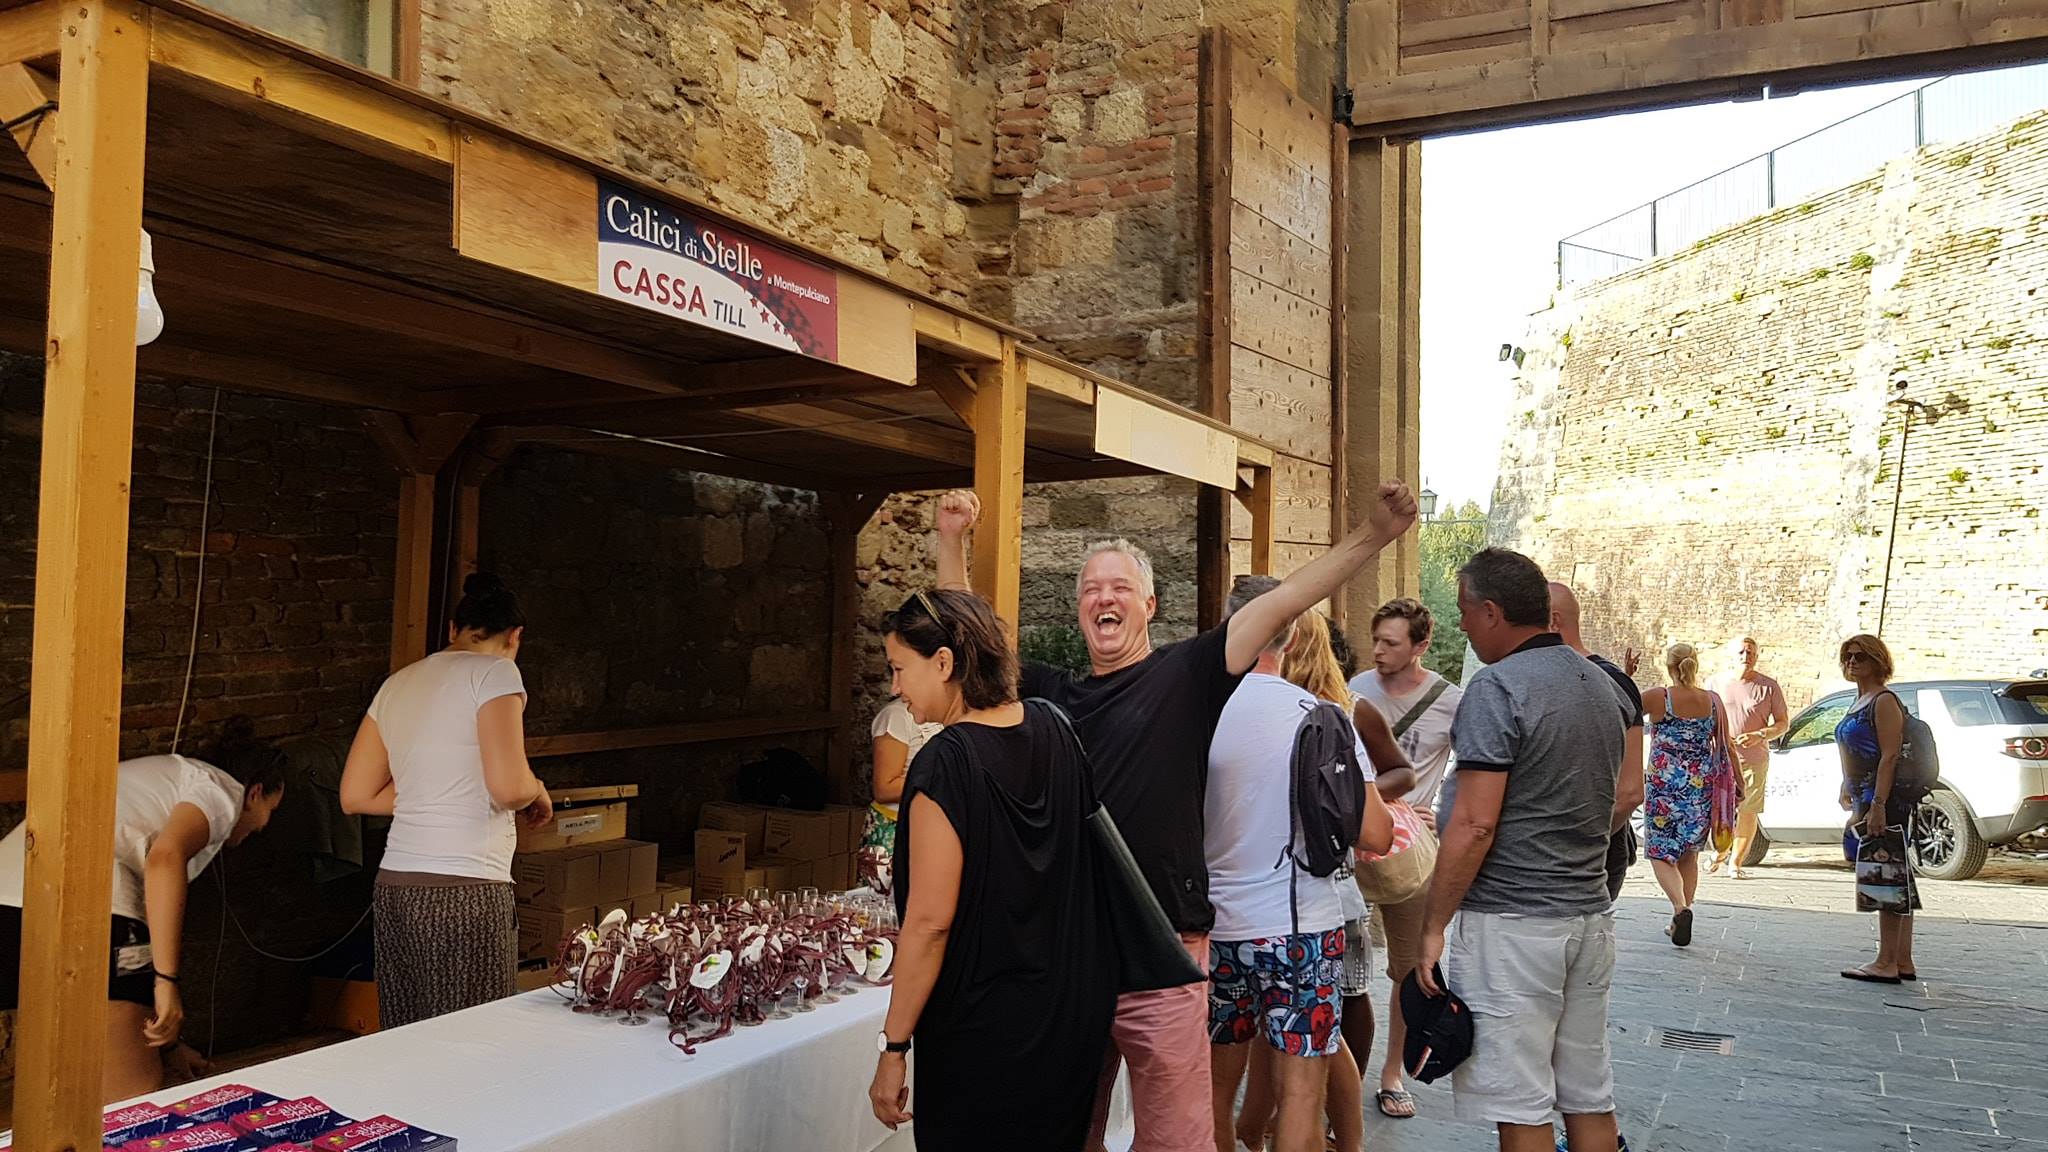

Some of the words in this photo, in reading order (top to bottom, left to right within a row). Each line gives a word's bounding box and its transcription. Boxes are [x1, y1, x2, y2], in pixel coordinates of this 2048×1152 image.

[606, 195, 681, 253] Calici
[684, 238, 698, 259] di
[701, 230, 763, 281] Stelle
[773, 274, 831, 305] Montepulciano
[613, 260, 708, 318] CASSA
[713, 299, 747, 329] TILL
